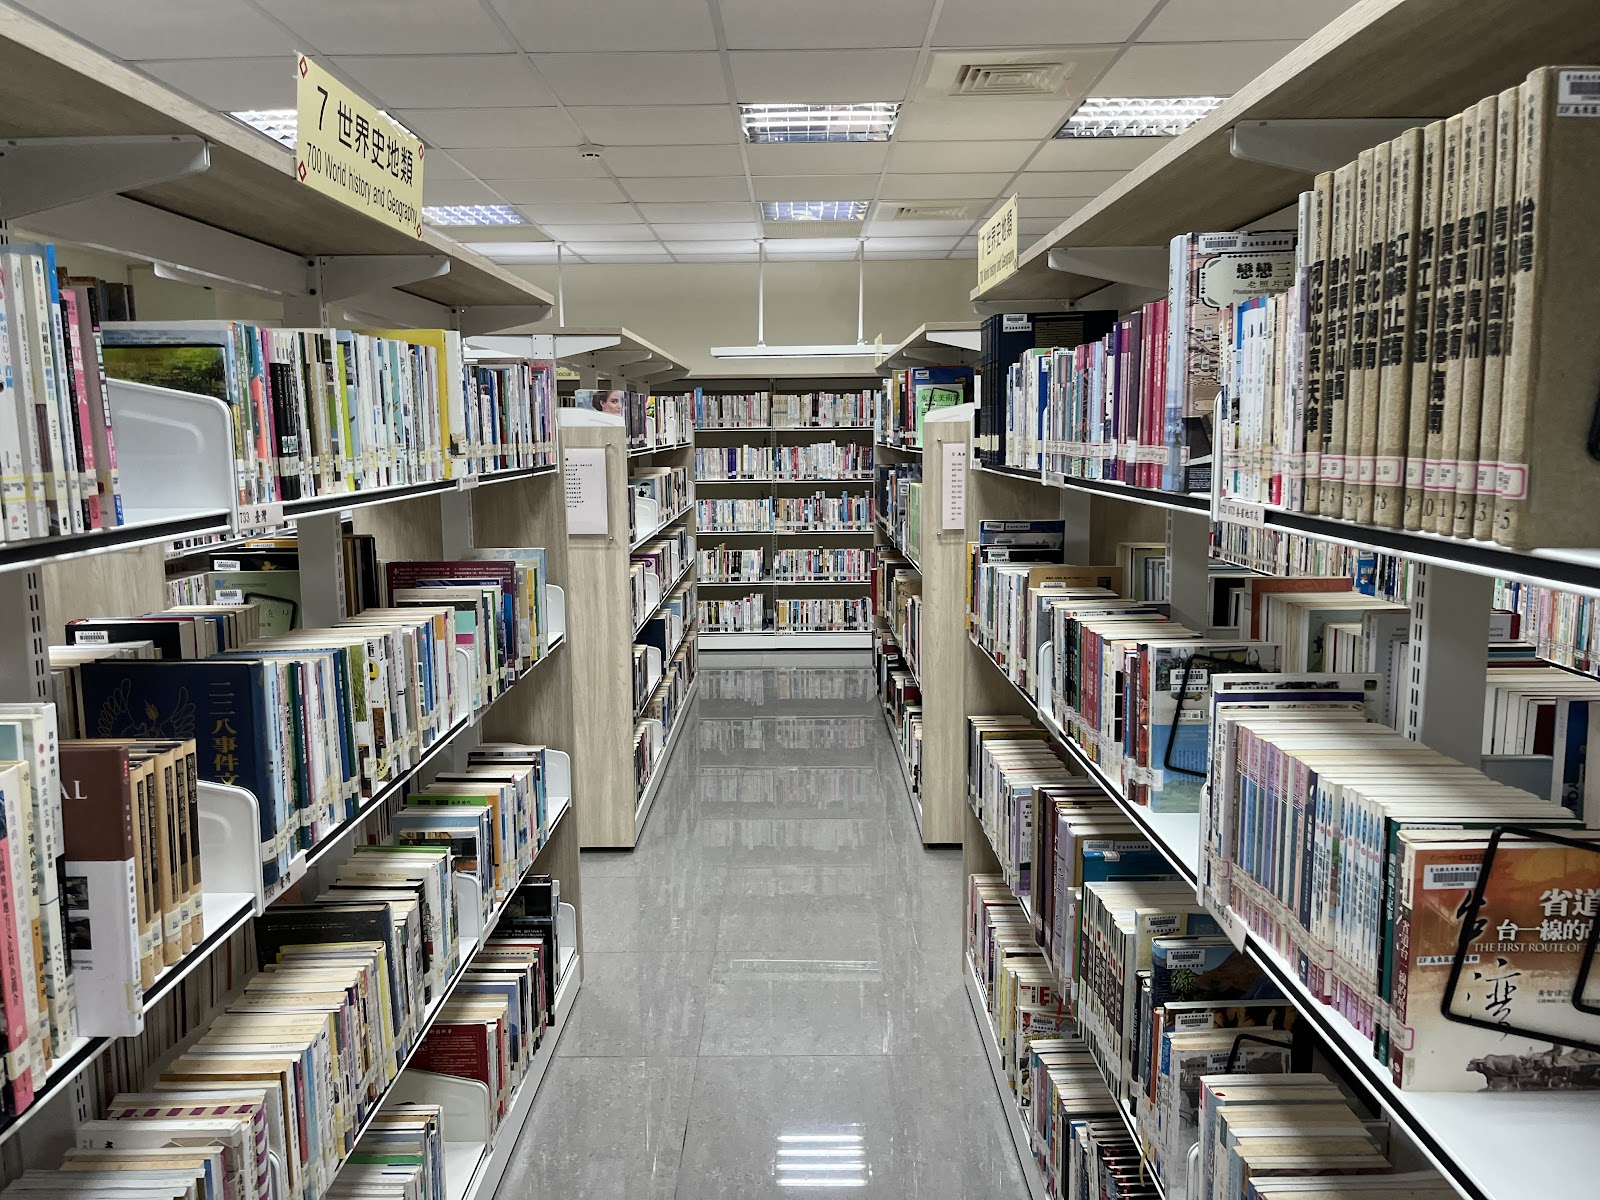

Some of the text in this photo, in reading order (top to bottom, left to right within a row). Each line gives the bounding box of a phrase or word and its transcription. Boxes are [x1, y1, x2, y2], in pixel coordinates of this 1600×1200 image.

[306, 142, 417, 230] 700 World history and Geography
[317, 85, 413, 187] 7 世界史地類
[1308, 259, 1325, 433] 河北北京天津
[1352, 247, 1368, 370] 山東河南
[1365, 242, 1383, 370] 湖北湖南
[1413, 227, 1434, 363] 浙江福建
[1428, 223, 1454, 434] 廣東香港海南
[1449, 216, 1471, 360] 廣西雲南
[1465, 211, 1487, 359] 四川貴州
[254, 509, 268, 524] 臺灣
[209, 681, 241, 785] 二二八事件文
[1474, 943, 1496, 953] THE
[1497, 943, 1526, 953] FIRST
[1528, 943, 1566, 953] ROUTE
[1566, 943, 1582, 953] OF
[1539, 888, 1600, 917] 省道
